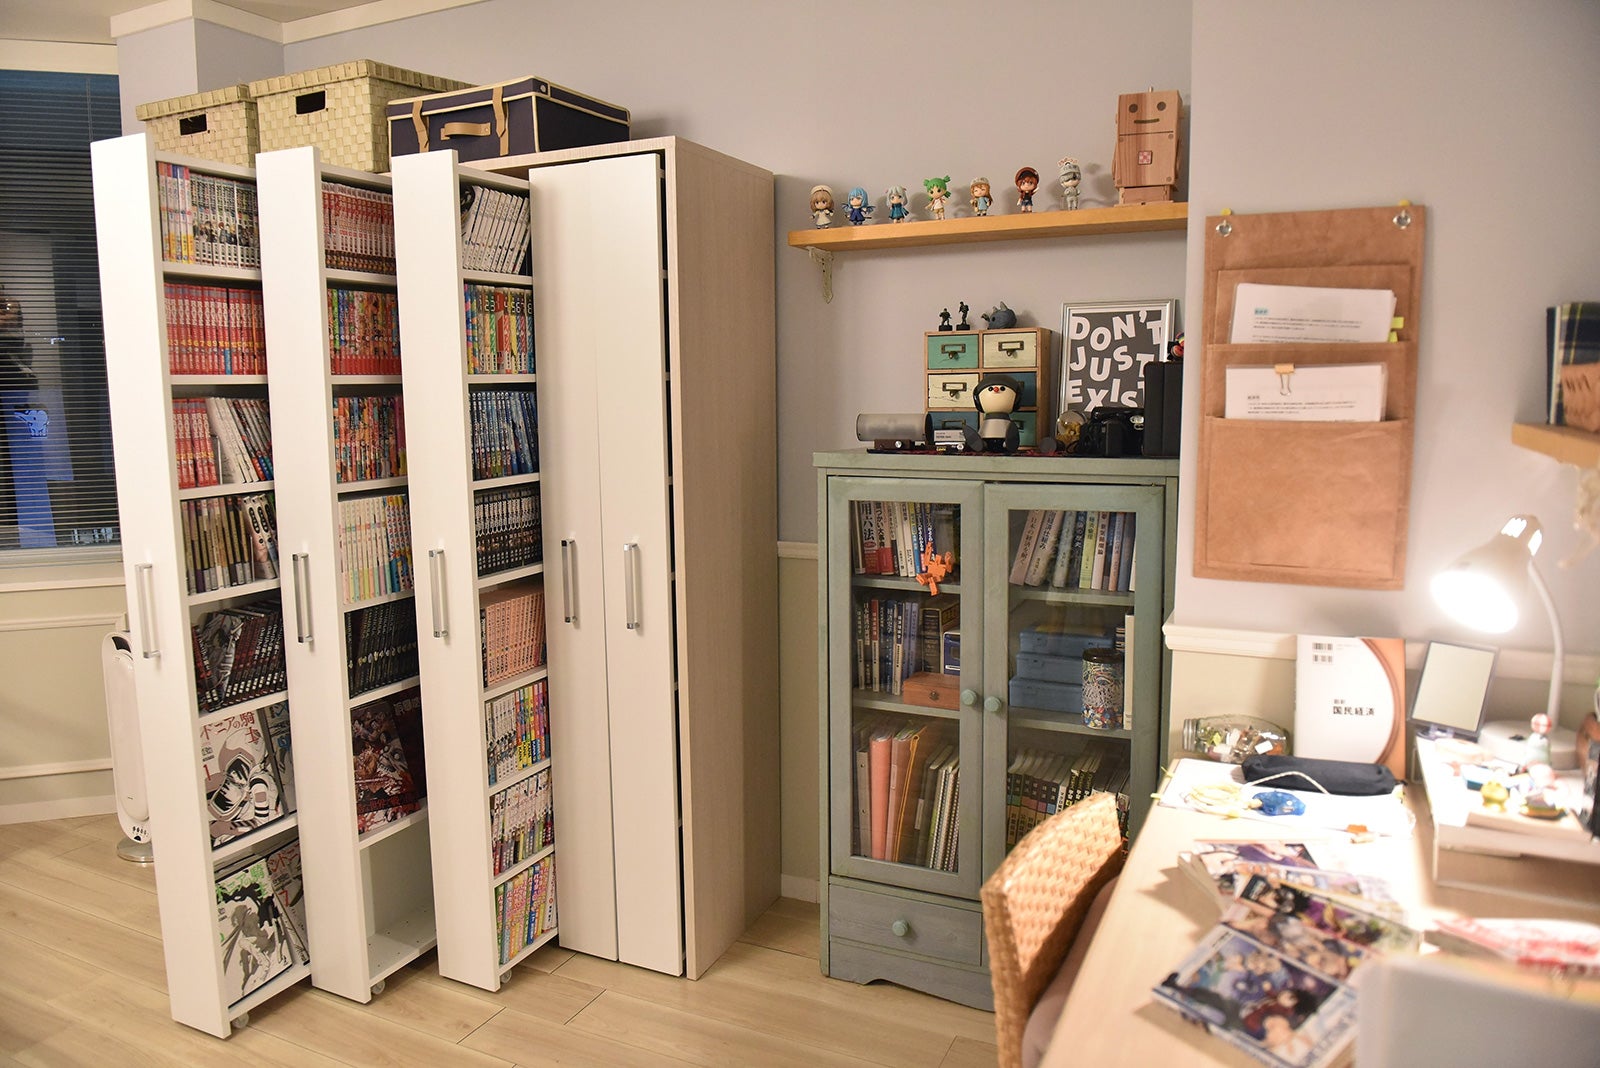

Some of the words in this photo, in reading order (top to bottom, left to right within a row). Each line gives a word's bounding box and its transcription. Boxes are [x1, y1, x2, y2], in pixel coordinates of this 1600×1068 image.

[1070, 310, 1164, 351] DON'T
[1070, 346, 1154, 382] JUST
[1332, 706, 1375, 716] 国民経済
[203, 764, 211, 781] 1
[278, 889, 290, 908] 7
